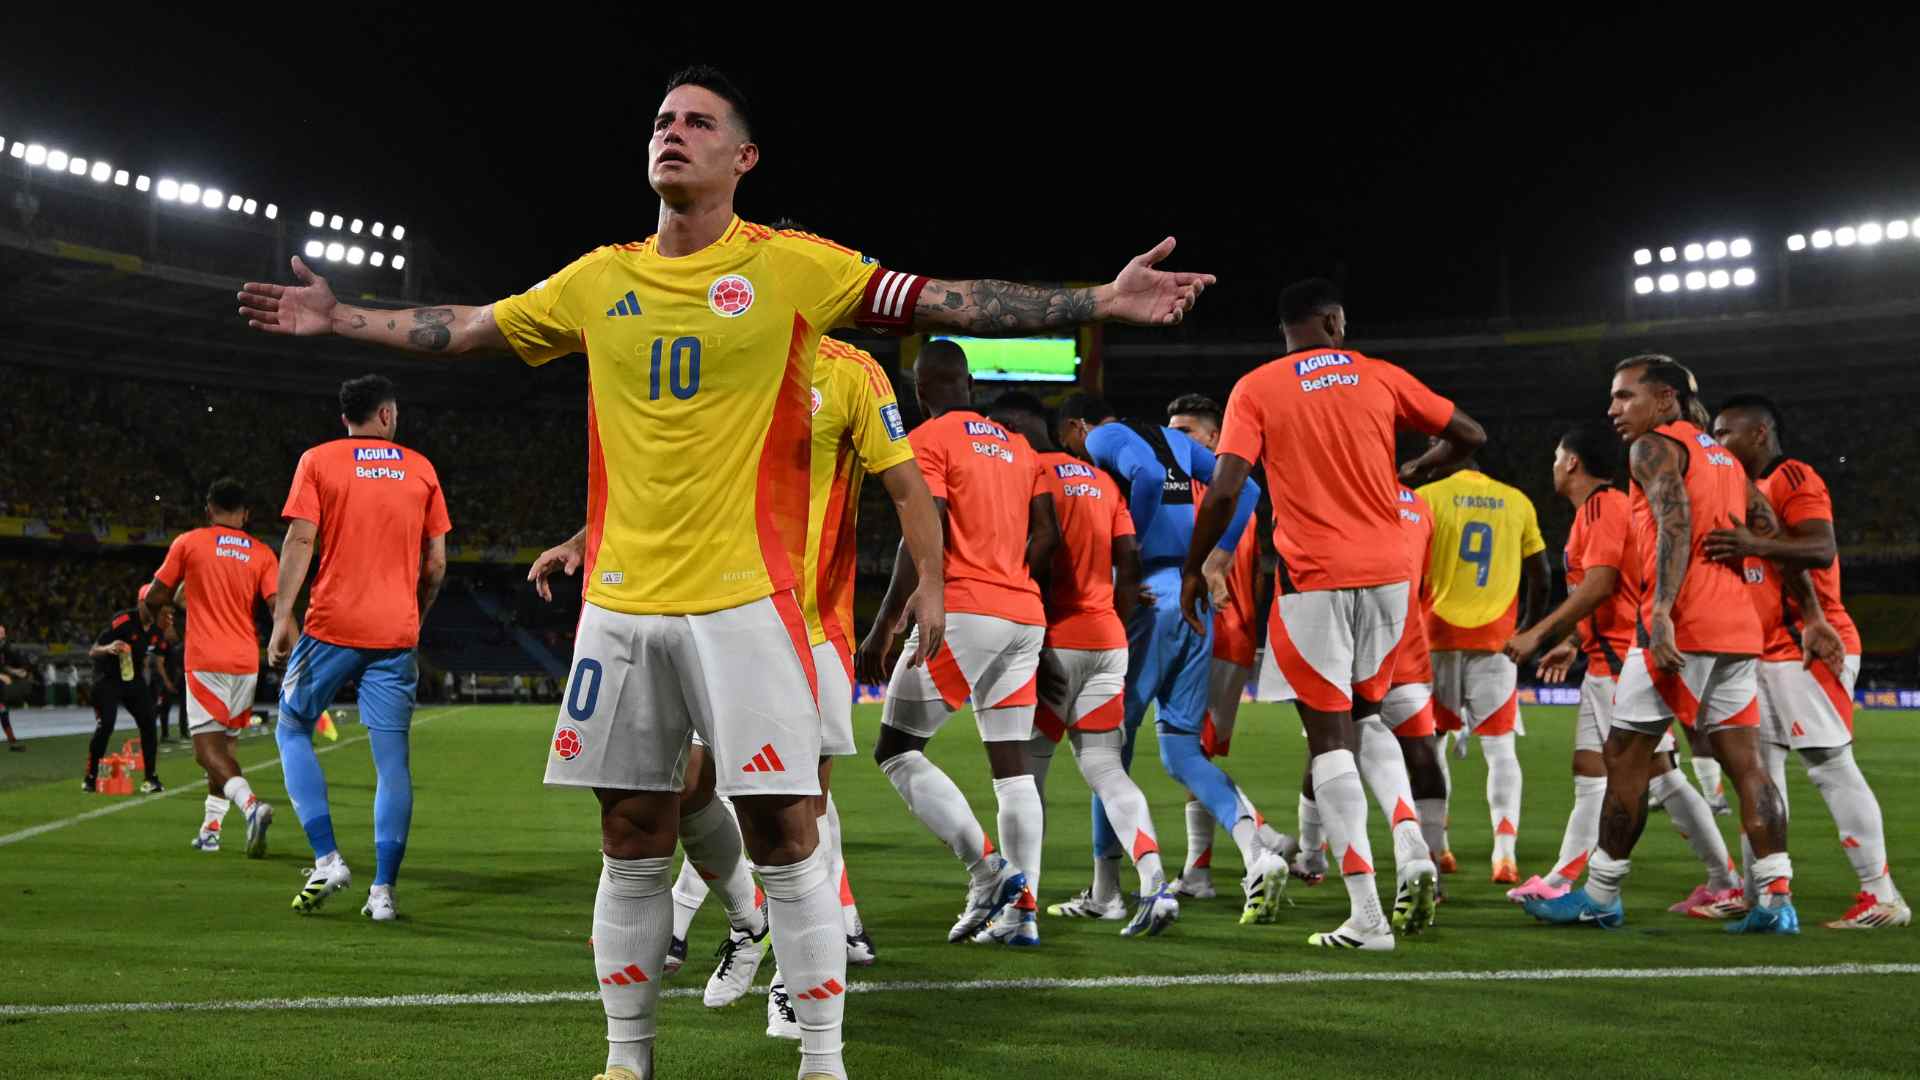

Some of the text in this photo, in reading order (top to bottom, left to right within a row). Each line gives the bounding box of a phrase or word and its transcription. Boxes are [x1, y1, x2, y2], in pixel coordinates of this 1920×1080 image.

[648, 336, 702, 401] 10
[1301, 372, 1359, 392] BetPlay
[355, 466, 406, 480] BetPlay
[1458, 521, 1493, 588] 9
[567, 657, 603, 722] 0
